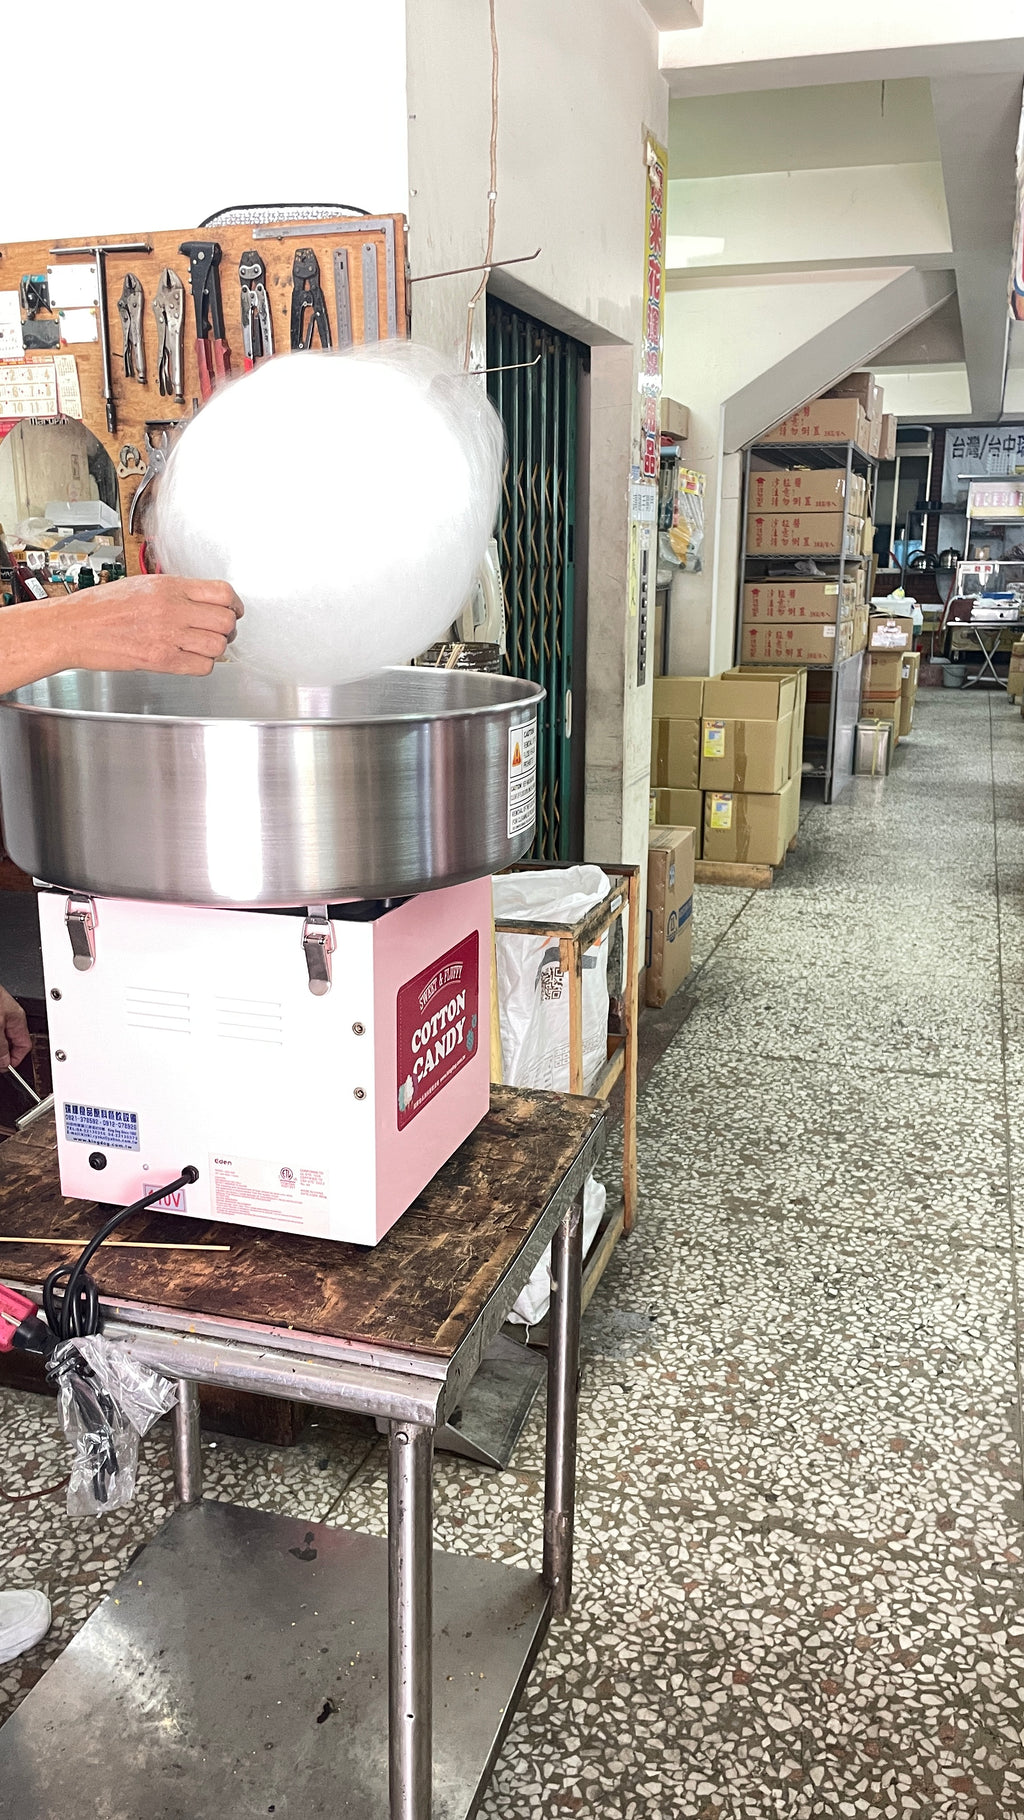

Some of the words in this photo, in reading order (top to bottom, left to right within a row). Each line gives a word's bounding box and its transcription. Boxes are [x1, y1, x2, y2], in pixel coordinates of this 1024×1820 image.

[439, 973, 443, 987] &
[411, 989, 466, 1054] COTTON
[413, 1016, 466, 1083] CANDY
[148, 1189, 181, 1208] 0V
